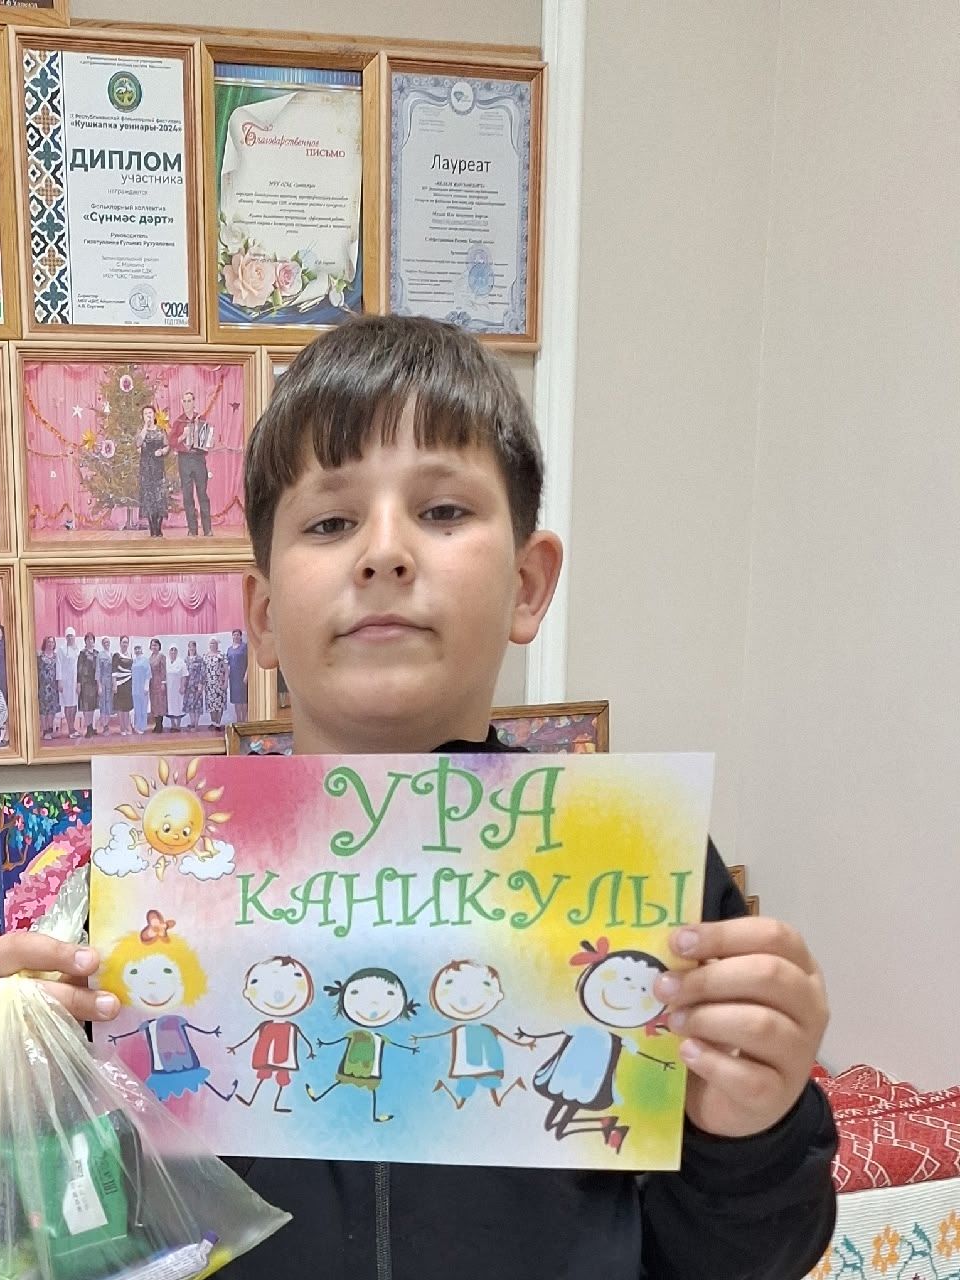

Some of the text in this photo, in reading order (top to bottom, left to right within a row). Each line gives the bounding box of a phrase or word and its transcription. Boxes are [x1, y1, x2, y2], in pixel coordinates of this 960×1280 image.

[242, 121, 320, 148] Благодарственное
[69, 148, 182, 172] ДИПЛОМ
[306, 148, 346, 158] ПИСЬМО
[430, 153, 492, 174] Лауреат
[121, 173, 184, 187] участника
[83, 211, 174, 226] «Сүнмәс дәрт»
[322, 756, 565, 857] УРА
[234, 867, 693, 938] КАНИКУЛЫ
